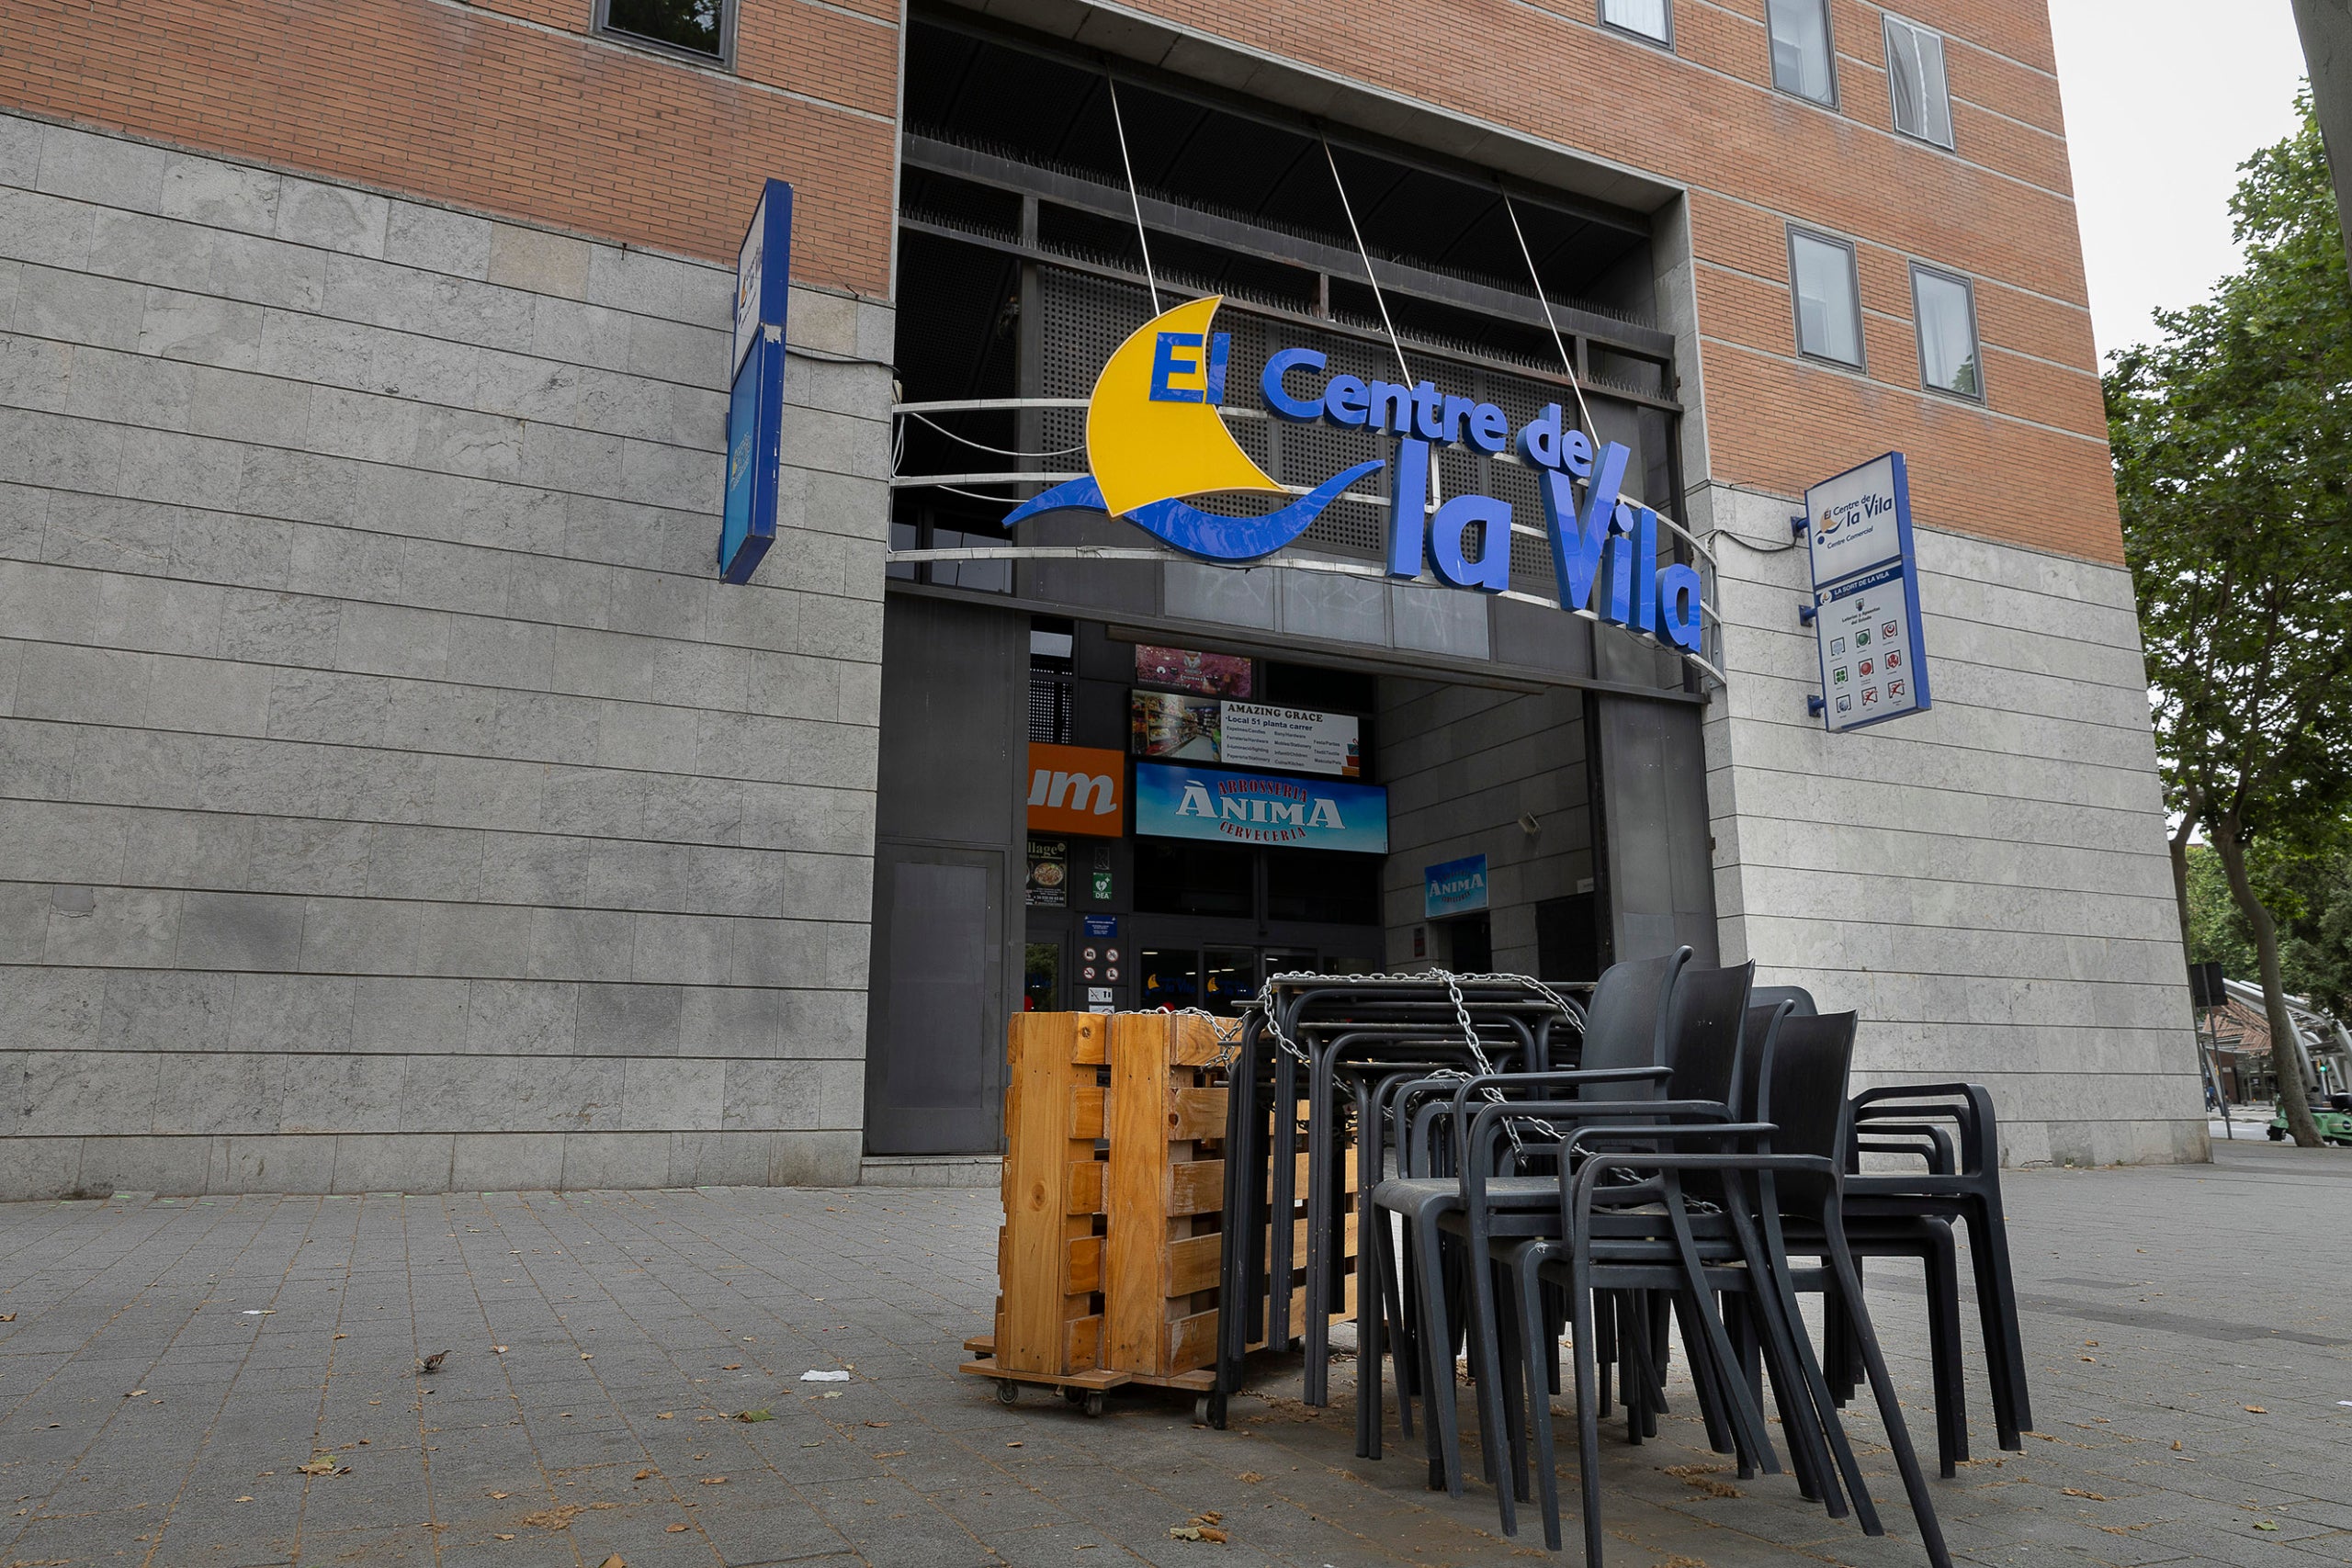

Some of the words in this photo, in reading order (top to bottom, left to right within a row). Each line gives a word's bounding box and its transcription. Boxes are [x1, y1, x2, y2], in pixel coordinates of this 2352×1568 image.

[1148, 332, 1231, 405] El
[1260, 347, 1509, 457] Centre
[1515, 402, 1594, 478] de
[1833, 500, 1860, 516] Centre
[1860, 494, 1871, 504] de
[1847, 511, 1860, 527] la
[1864, 493, 1893, 519] Vila
[1386, 438, 1512, 594] la
[1538, 441, 1702, 655] Vila
[1826, 538, 1846, 549] Centre
[1846, 525, 1874, 542] Comercial
[1842, 582, 1859, 592] SORT
[1859, 578, 1868, 587] DE
[1875, 571, 1890, 581] VILA
[1227, 704, 1282, 717] AMAZING
[1284, 710, 1324, 723] GRACE
[1251, 717, 1261, 726] 51
[1262, 719, 1288, 729] planta
[1289, 723, 1313, 731] carrer
[1218, 779, 1307, 803] ARROSSERIA
[1175, 780, 1347, 829] ÀNIMA
[1219, 820, 1306, 842] CERVECERIA
[1429, 873, 1486, 897] ÀNIMA
